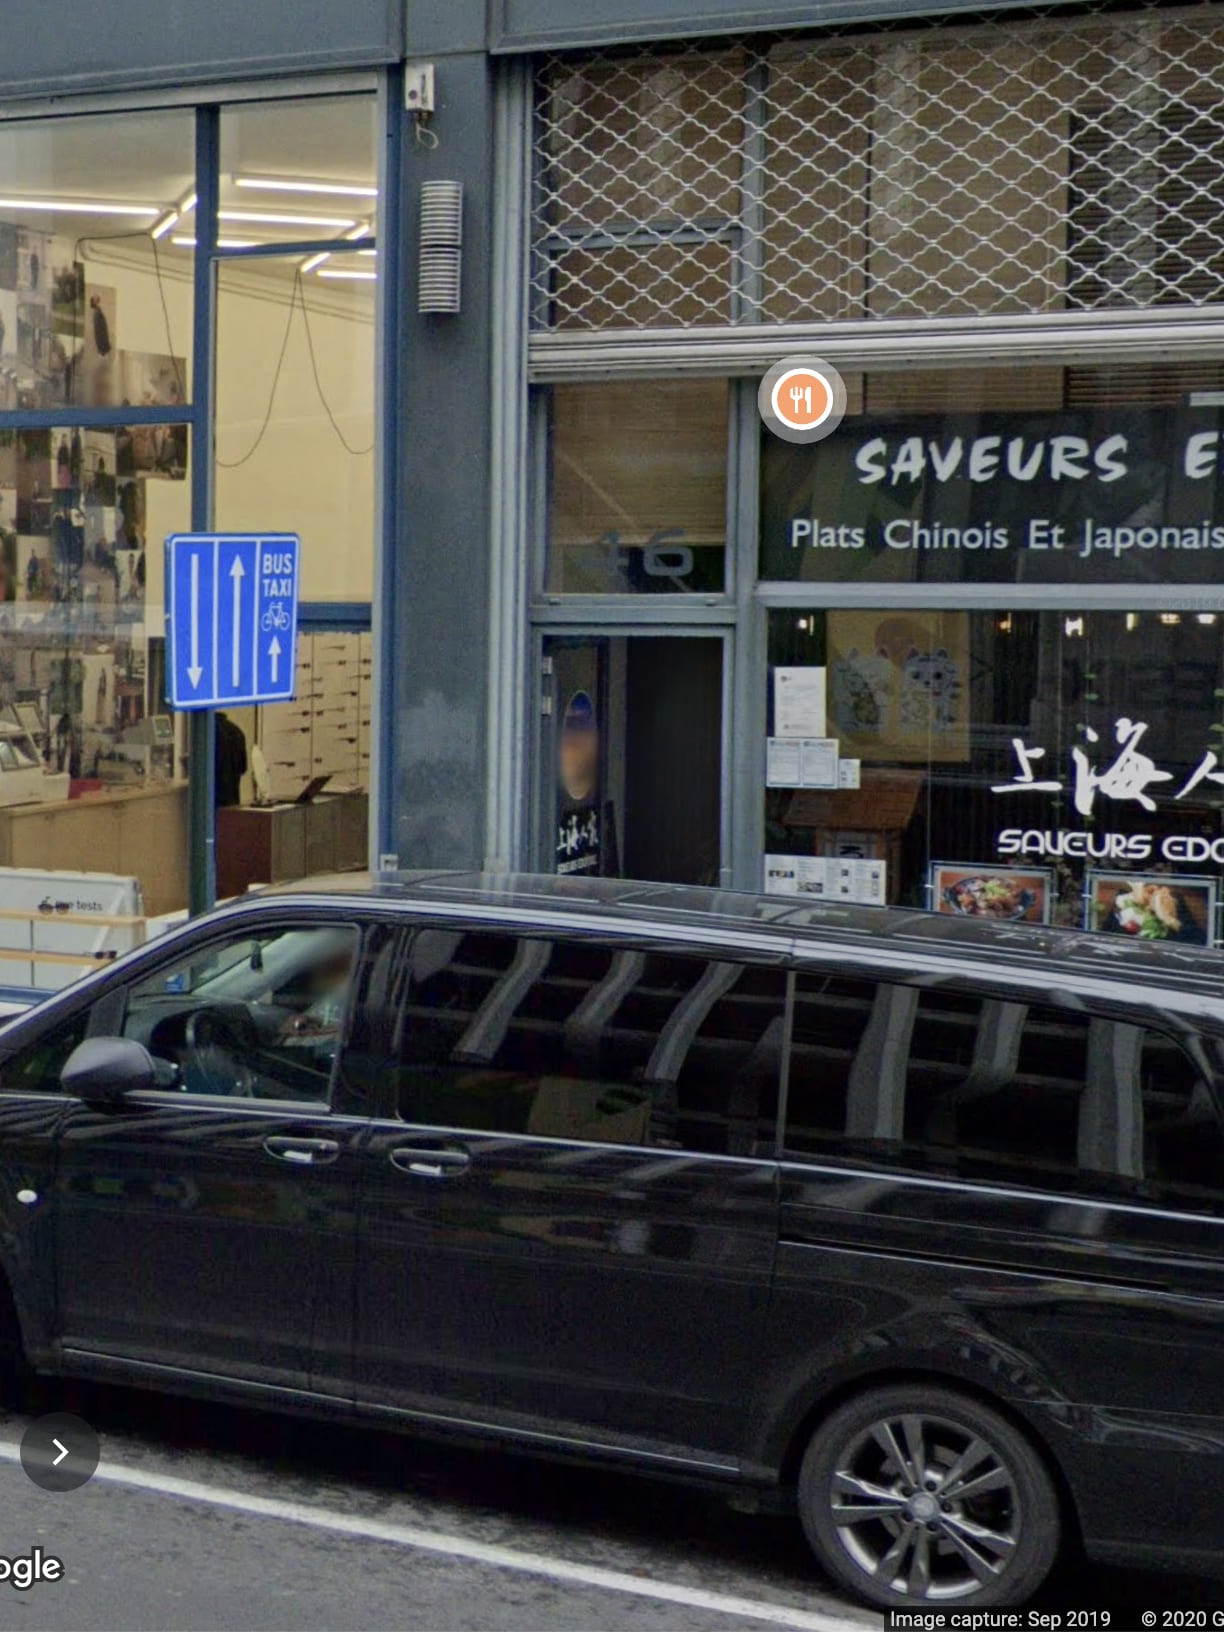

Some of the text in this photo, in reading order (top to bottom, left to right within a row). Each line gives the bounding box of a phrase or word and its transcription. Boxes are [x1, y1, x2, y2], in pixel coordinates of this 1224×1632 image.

[854, 433, 1130, 486] SAVEURS
[790, 518, 1224, 559] Plats Chinois Et Japonais
[262, 553, 293, 575] BUS
[262, 578, 292, 598] TAXI
[76, 899, 104, 911] tests
